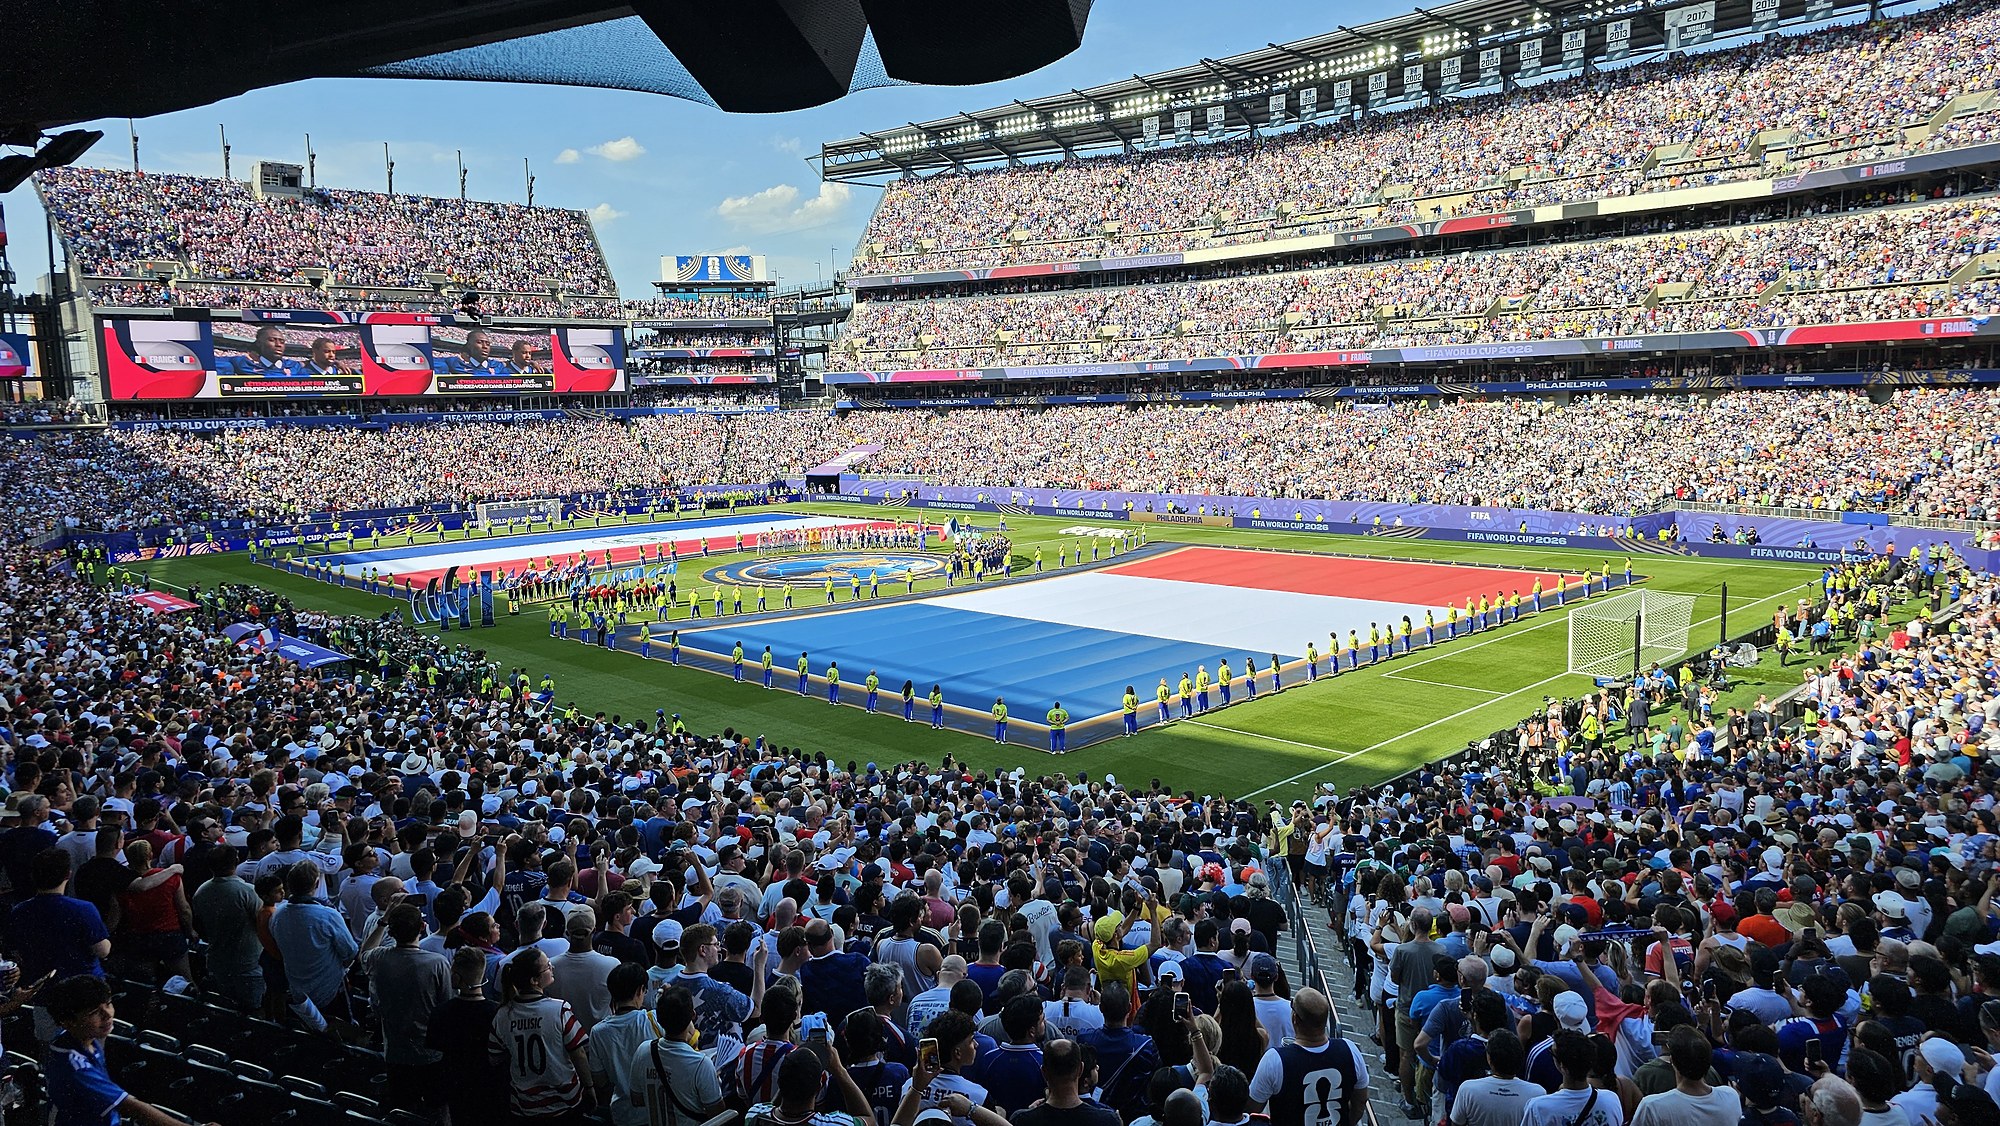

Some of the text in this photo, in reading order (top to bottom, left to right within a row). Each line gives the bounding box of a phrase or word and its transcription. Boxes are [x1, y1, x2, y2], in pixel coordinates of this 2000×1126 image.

[1756, 0, 1776, 9] 2019
[1686, 11, 1707, 22] 2017
[1685, 23, 1706, 32] WORLD
[1609, 30, 1628, 40] 2013
[1680, 28, 1712, 40] CHAMPIONS
[1564, 39, 1582, 49] 2010
[1522, 48, 1540, 58] 2006
[1481, 58, 1498, 68] 2004
[1442, 66, 1459, 75] 2003
[1405, 73, 1421, 82] 2002
[1370, 80, 1385, 90] 2001
[1873, 161, 1906, 176] FRANCE
[1499, 215, 1518, 223] FRANCE
[1356, 233, 1373, 241] FRANCE
[1115, 259, 1130, 267] FIFA
[1131, 257, 1158, 266] WORLD
[1159, 255, 1173, 264] CUP
[1062, 263, 1081, 271] FRANCE
[898, 275, 914, 284] FRANCE
[271, 312, 291, 320] FRANCE
[1941, 321, 1977, 333] FRANCE
[1614, 339, 1643, 350] FRANCE
[1425, 345, 1533, 357] FIFA WORLD CUP 2026
[149, 355, 176, 364] FRANCE
[387, 356, 409, 364] FRANCE
[579, 356, 598, 364] FRANCE
[1351, 353, 1372, 361] FRANCE
[1152, 362, 1169, 370] FRANCE
[966, 370, 983, 378] FRANCE
[1526, 381, 1608, 390] PHILADELPHIA
[513, 412, 542, 420] 2026
[134, 420, 266, 431] FIFA WORLD CUP 2026
[1157, 514, 1203, 524] PHILADELPHIA
[1471, 512, 1490, 521] FIFA
[1251, 520, 1329, 531] FIFA WORLD CUP 2026
[1467, 532, 1567, 546] FIFA WORLD CUP 2026
[1750, 548, 1774, 558] FIFA
[1775, 550, 1817, 560] WORLD
[1818, 552, 1841, 561] CUP
[510, 1016, 543, 1032] PULISIC
[515, 1034, 547, 1077] 10
